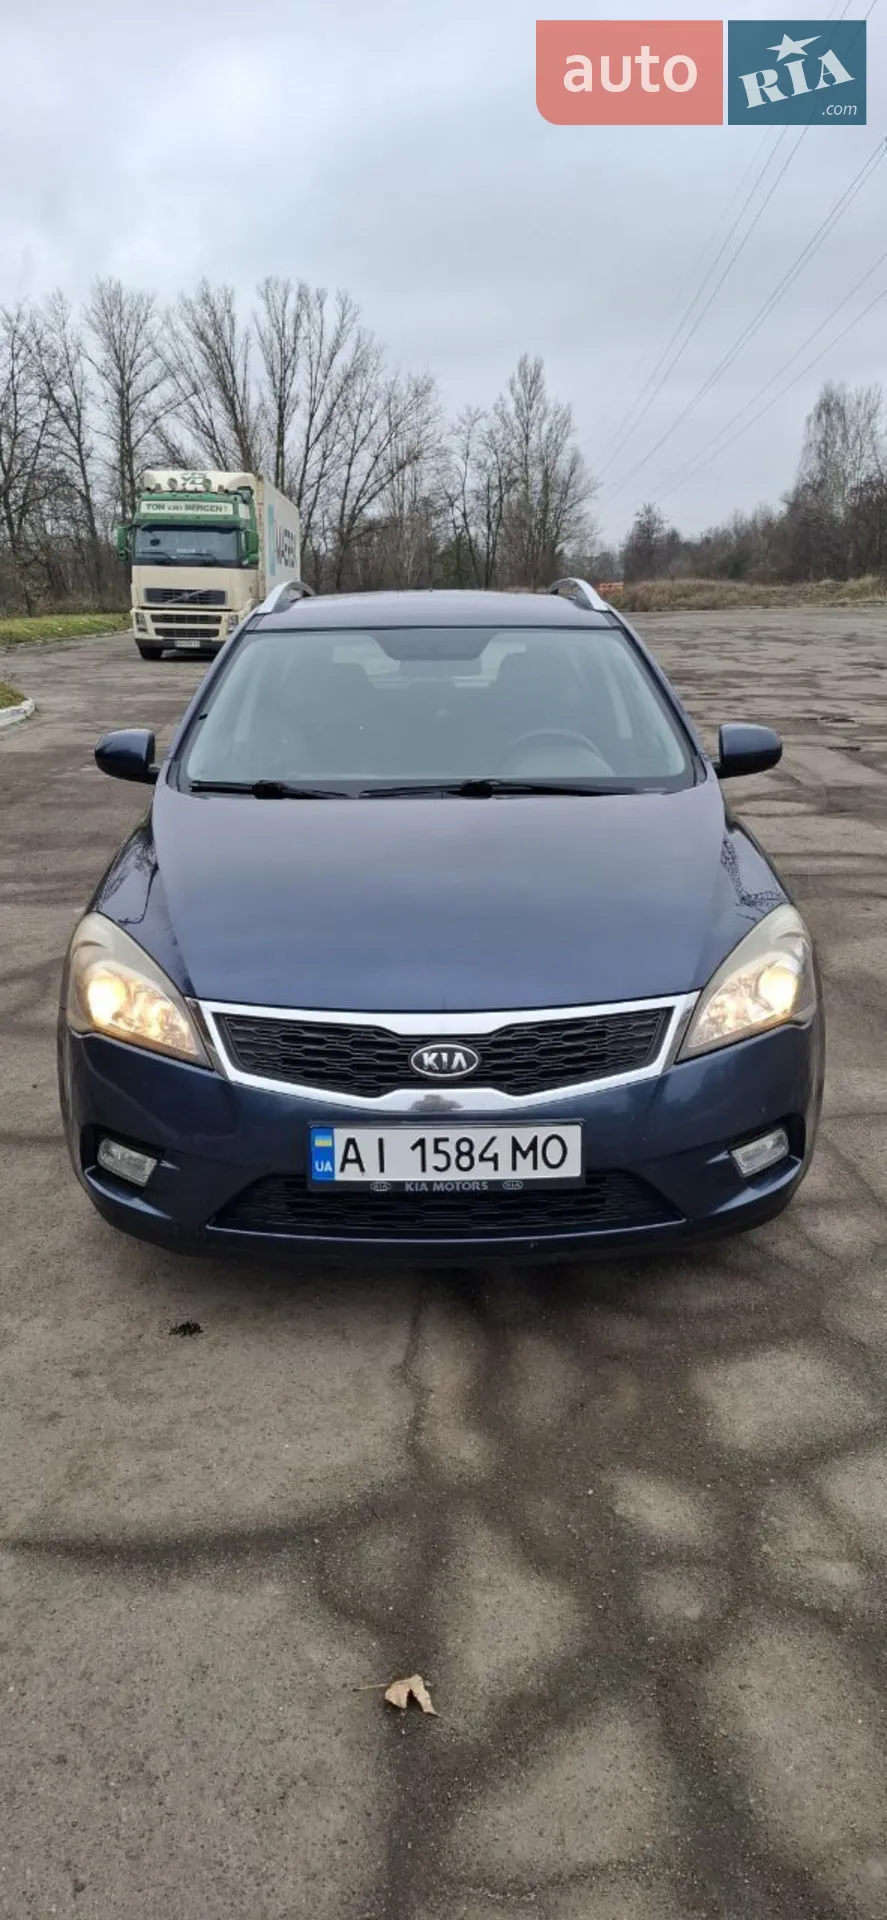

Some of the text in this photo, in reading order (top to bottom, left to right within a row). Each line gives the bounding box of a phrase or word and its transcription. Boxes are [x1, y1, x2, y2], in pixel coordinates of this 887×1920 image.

[145, 503, 166, 511] TON
[422, 1052, 467, 1071] KIA
[339, 1133, 568, 1173] AI 1584 MO
[315, 1162, 333, 1173] UA
[404, 1181, 488, 1192] KIA MOTORS
